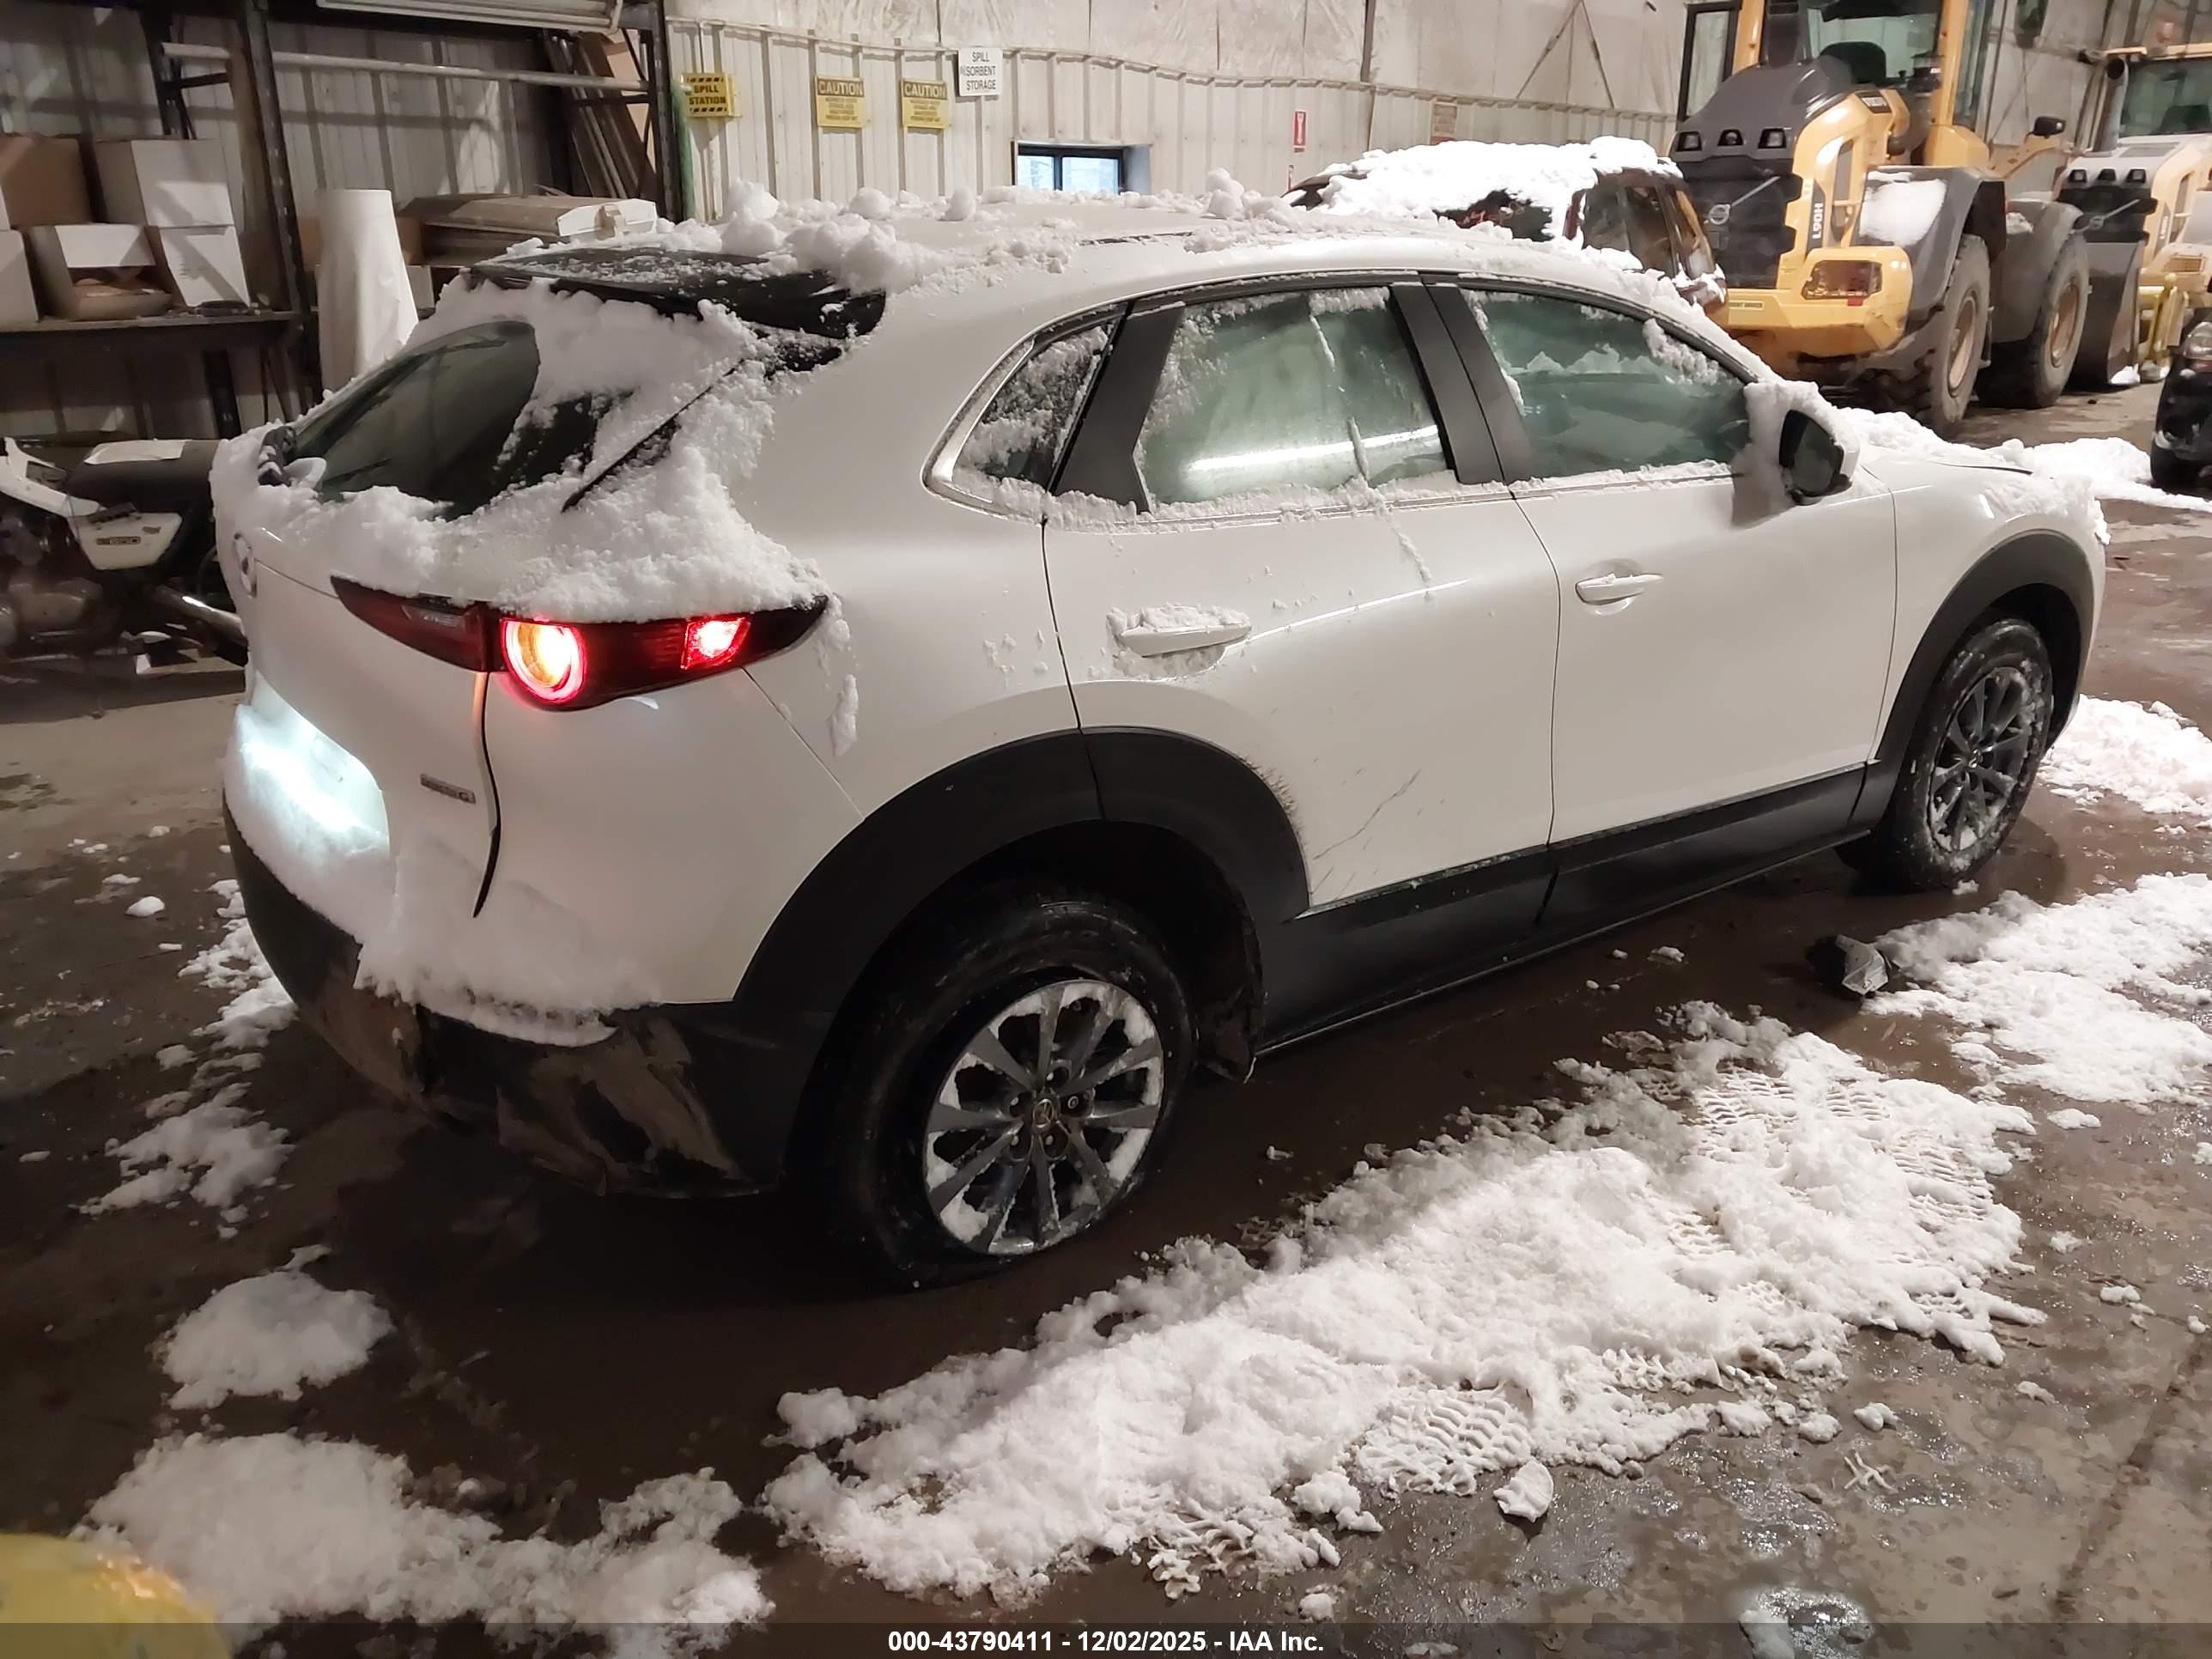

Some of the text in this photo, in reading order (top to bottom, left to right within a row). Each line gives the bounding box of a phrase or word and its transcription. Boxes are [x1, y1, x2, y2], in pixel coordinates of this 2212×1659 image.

[971, 52, 989, 62] SPILL
[693, 84, 719, 94] SPILL
[818, 81, 863, 95] CAUTION
[967, 79, 996, 90] STORAGE
[904, 83, 946, 99] CAUTION
[689, 96, 726, 106] STATION
[1812, 203, 1823, 239] L90H
